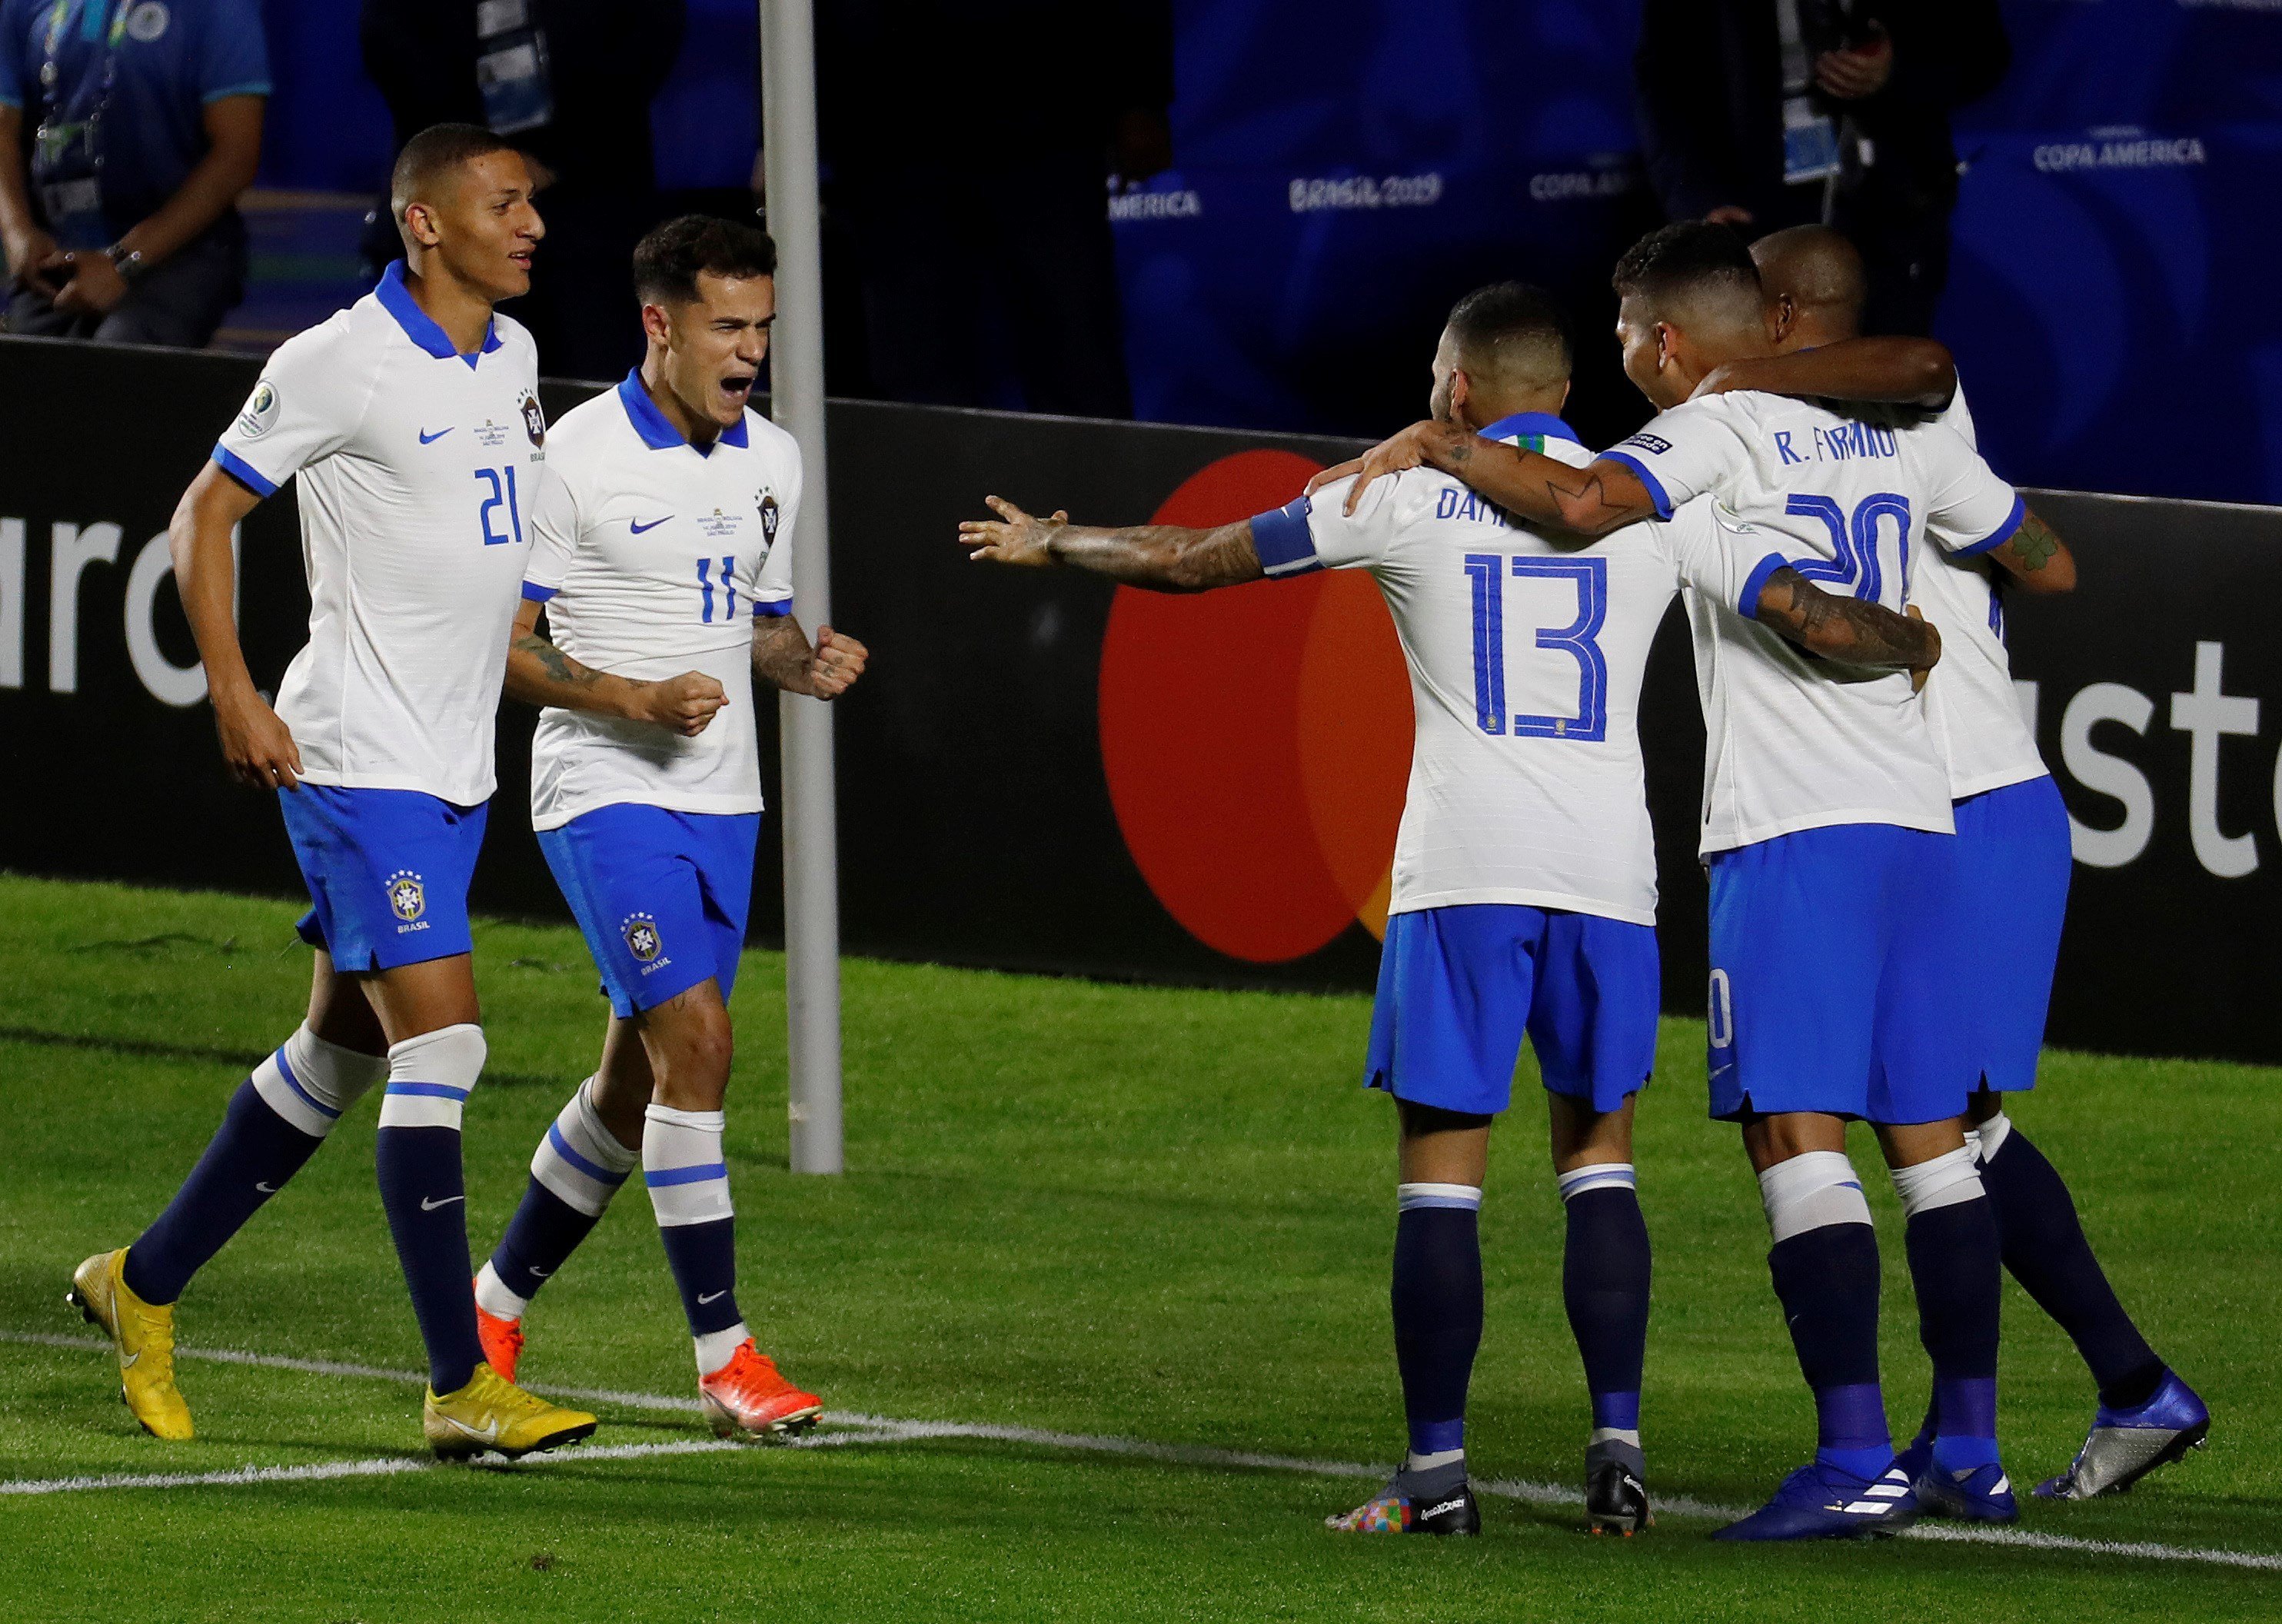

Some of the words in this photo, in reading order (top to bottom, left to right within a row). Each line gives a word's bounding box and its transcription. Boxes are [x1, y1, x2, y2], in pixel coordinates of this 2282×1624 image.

[1107, 190, 1199, 221] MERICA
[474, 465, 522, 546] 21
[1785, 491, 1911, 616] 20
[697, 556, 735, 624] 11
[1464, 553, 1608, 742] 13
[398, 920, 431, 933] BRASIL
[640, 957, 673, 976] BRASIL
